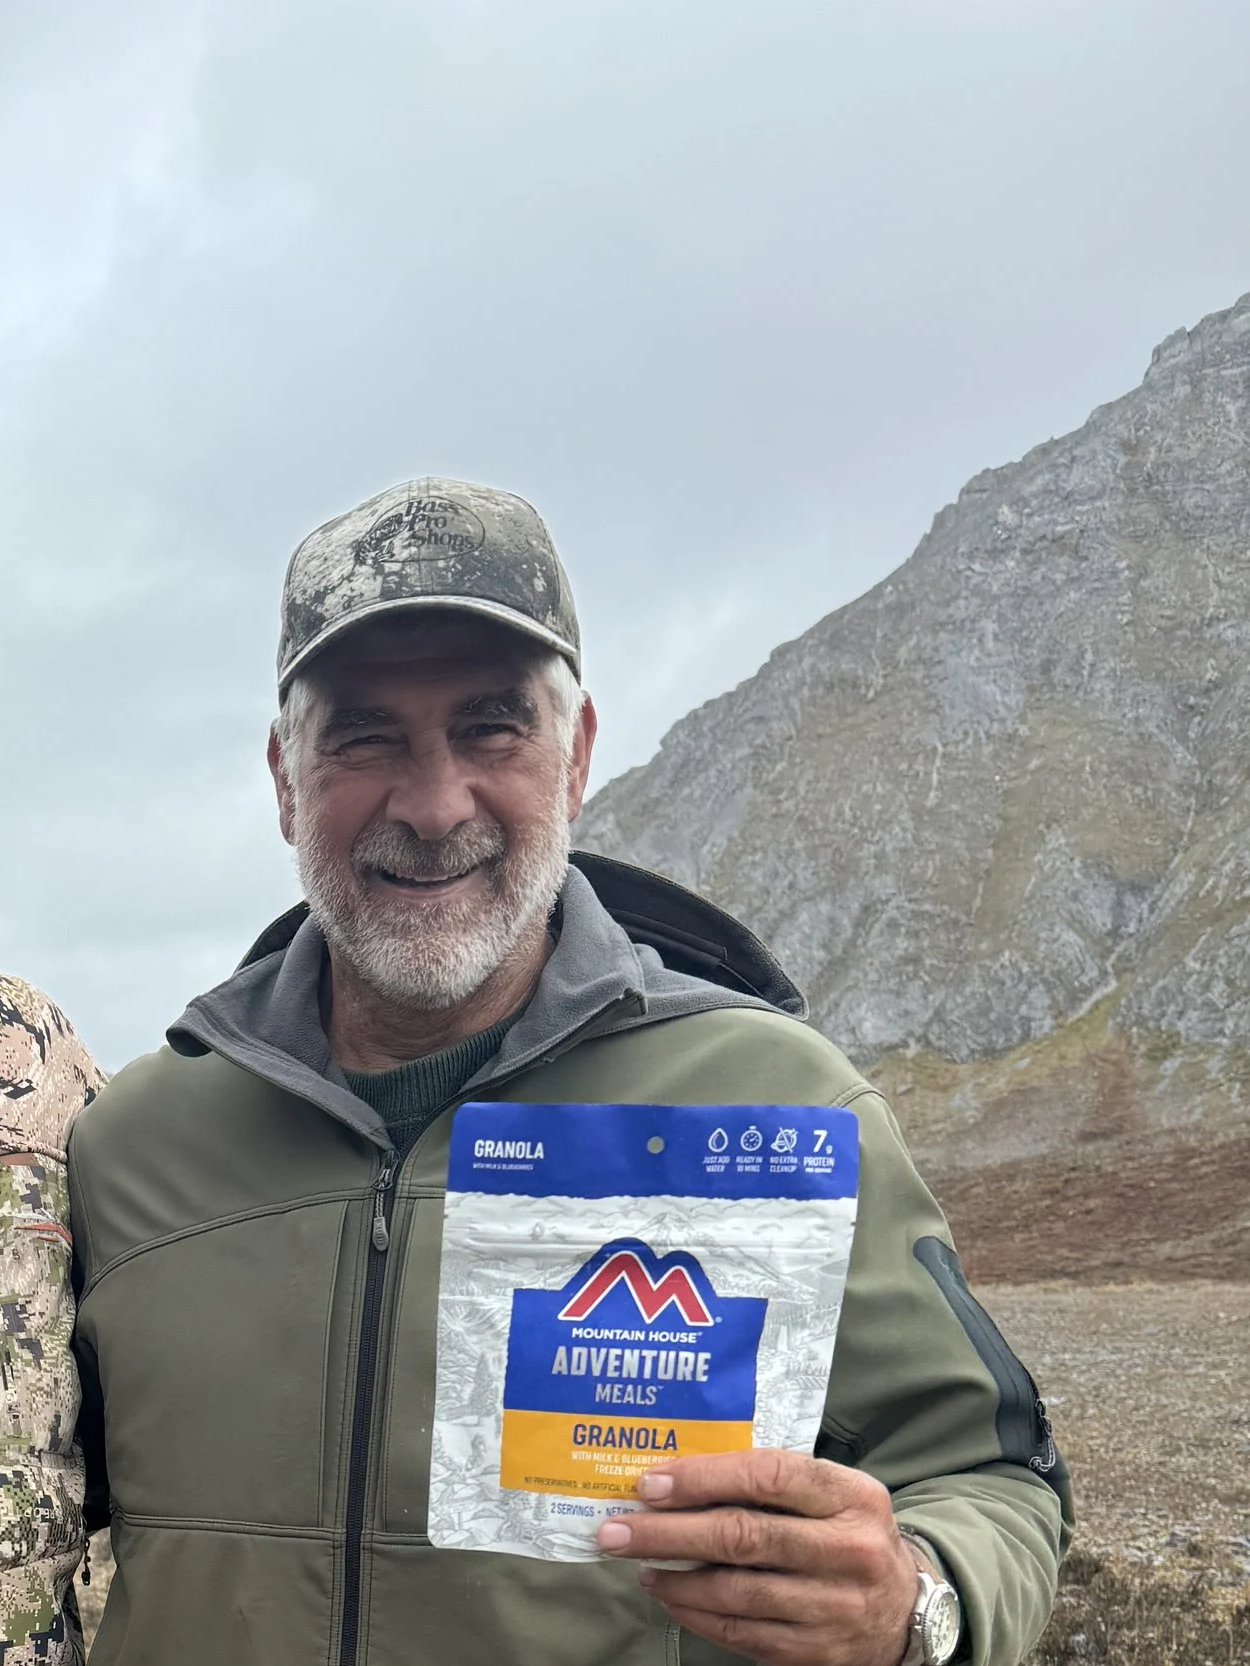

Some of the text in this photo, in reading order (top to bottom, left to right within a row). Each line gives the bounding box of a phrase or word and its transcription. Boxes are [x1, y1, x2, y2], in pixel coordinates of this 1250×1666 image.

[405, 500, 460, 516] Bass
[408, 514, 448, 532] Pro
[408, 529, 476, 552] Shops
[474, 1139, 545, 1159] GRANOLA
[803, 1156, 836, 1168] PROTEIN
[572, 1327, 698, 1344] MOUNTAIN HOUSE
[551, 1345, 712, 1383] ADVENTURE
[594, 1383, 658, 1405] MEALS
[572, 1423, 678, 1451] GRANOLA
[571, 1450, 591, 1461] WITH
[592, 1452, 613, 1463] MILK
[613, 1453, 620, 1463] &
[595, 1464, 624, 1475] FREEZE
[550, 1502, 556, 1514] 2
[556, 1502, 595, 1517] SERVINGS
